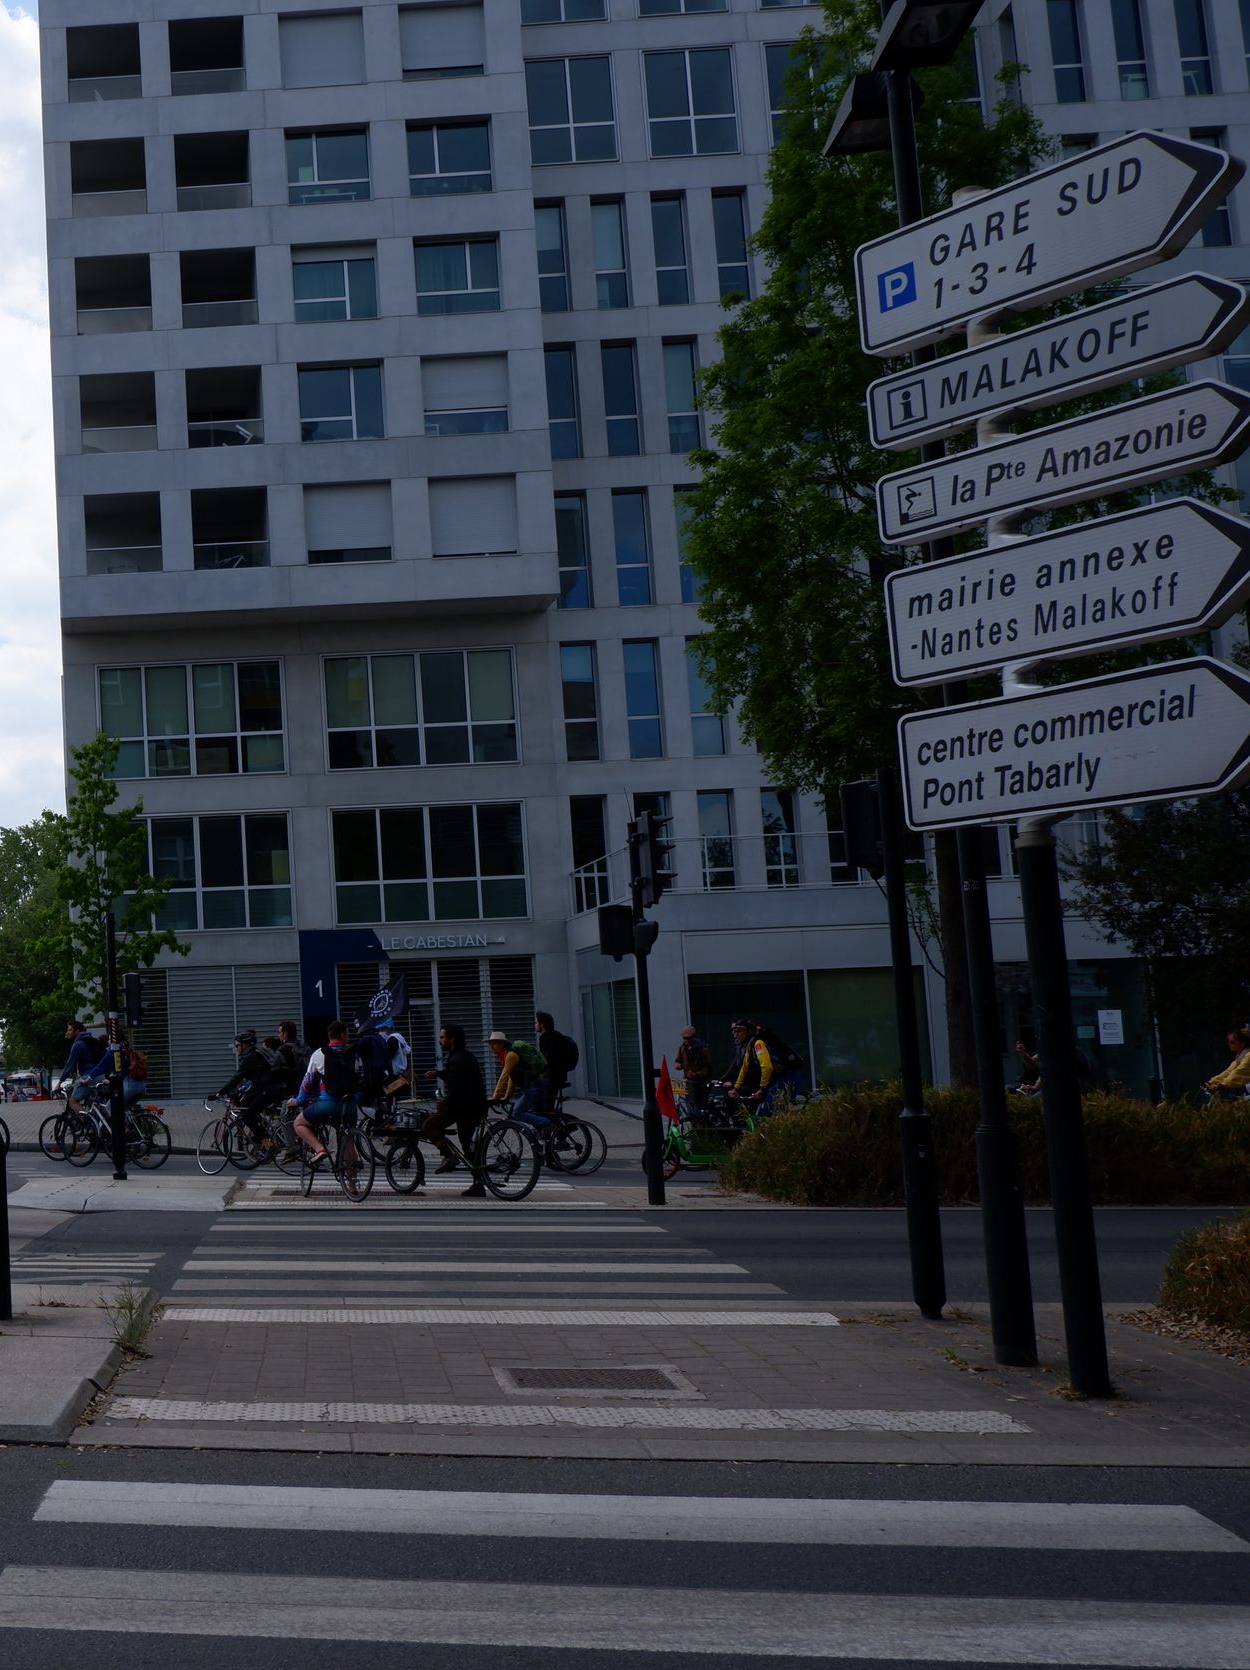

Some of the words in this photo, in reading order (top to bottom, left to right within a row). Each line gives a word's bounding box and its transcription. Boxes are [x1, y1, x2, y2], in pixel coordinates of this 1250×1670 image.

[930, 200, 1030, 266] GARE
[1058, 157, 1141, 217] SUD
[933, 243, 1037, 308] 1-3-4
[939, 311, 1149, 407] MALAKOFF
[951, 475, 976, 506] la
[1036, 409, 1206, 482] Amazonie
[908, 569, 1016, 618] mairie
[1036, 533, 1173, 589] annexe
[1034, 572, 1179, 635] Malakoff
[917, 727, 1003, 766] centre
[1014, 684, 1195, 748] commercial
[923, 772, 984, 809] Pont
[994, 752, 1101, 797] Tabarly
[382, 937, 400, 950] LE
[404, 934, 487, 949] CABESTAN
[315, 980, 324, 998] 1
